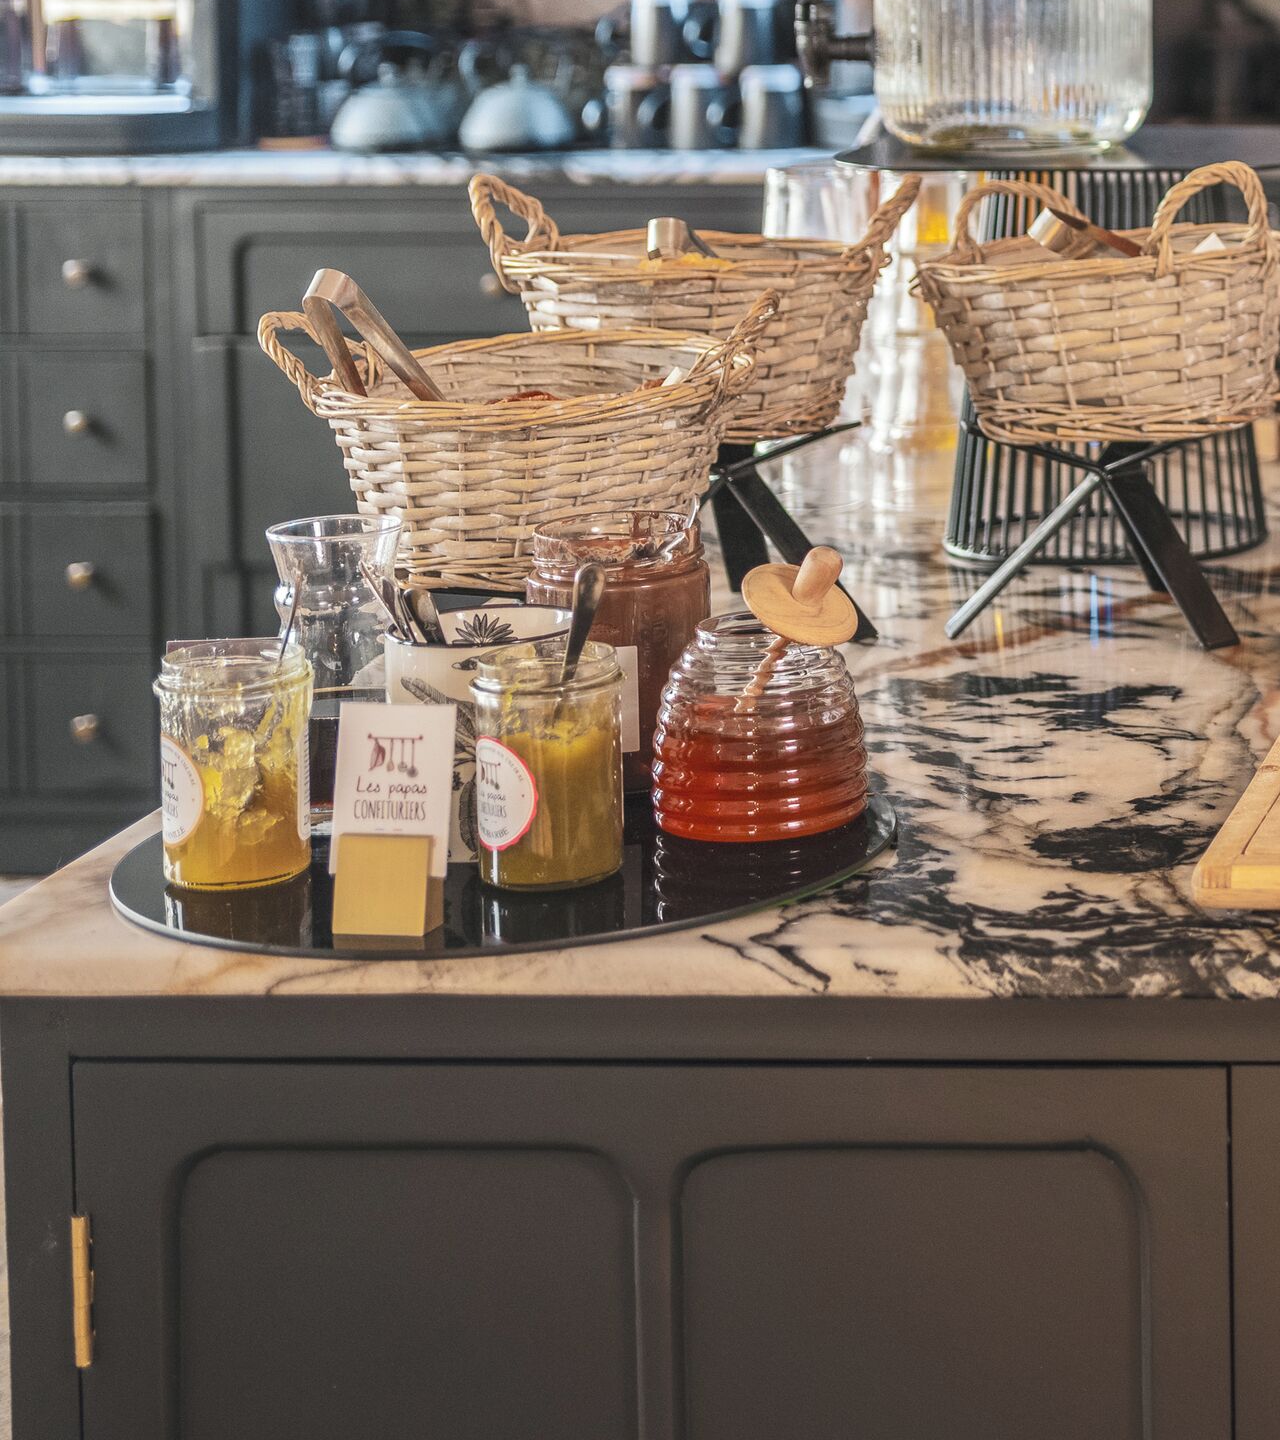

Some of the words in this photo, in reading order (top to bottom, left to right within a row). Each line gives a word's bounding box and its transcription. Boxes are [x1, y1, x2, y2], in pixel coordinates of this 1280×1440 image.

[356, 775, 381, 793] Les
[388, 783, 427, 799] papas
[353, 799, 426, 821] CONFITURIERS
